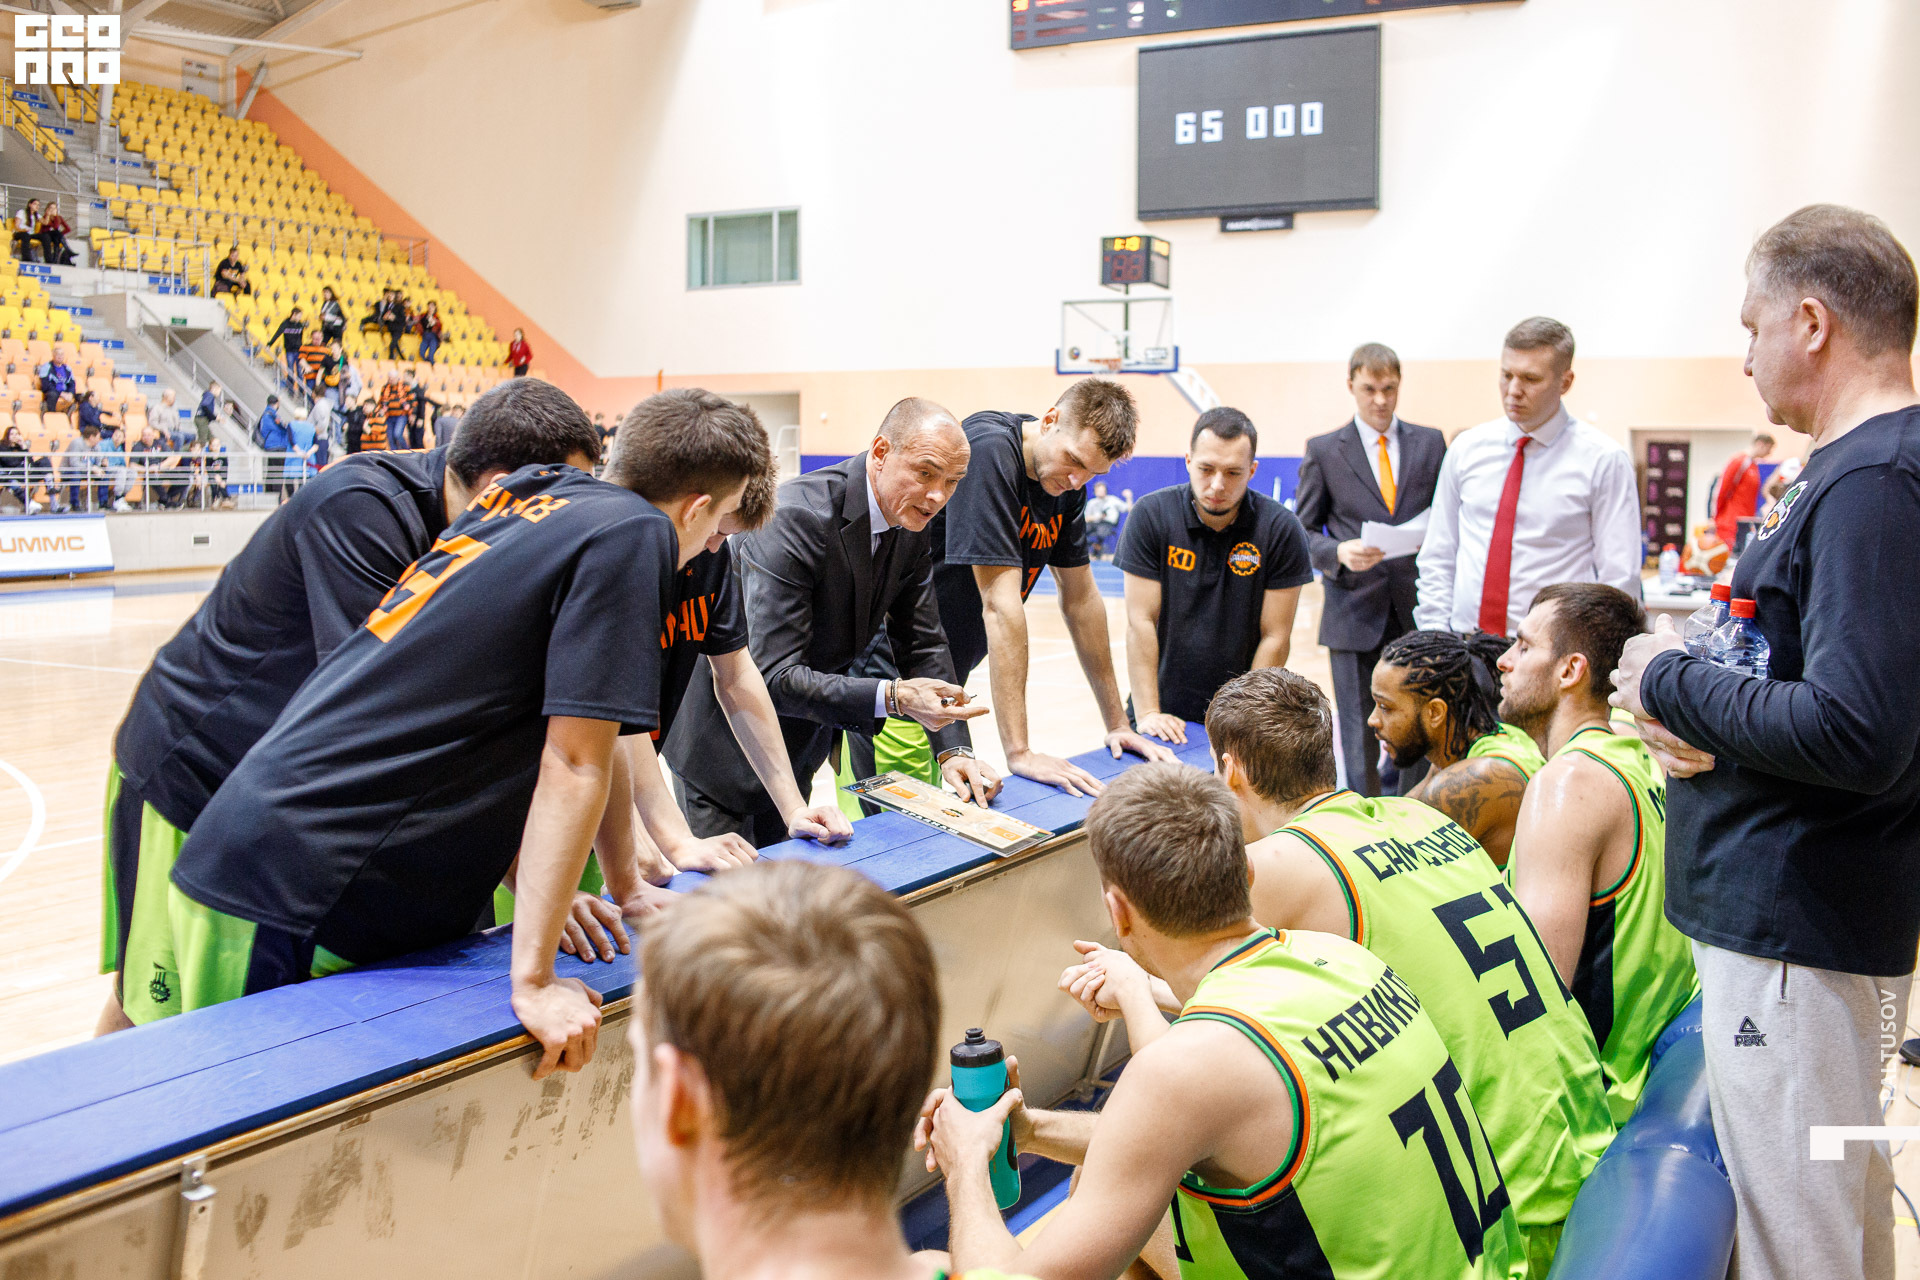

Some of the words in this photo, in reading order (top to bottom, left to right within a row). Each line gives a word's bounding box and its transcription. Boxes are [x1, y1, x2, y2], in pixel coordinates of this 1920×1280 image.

[1175, 109, 1223, 145] 65
[1246, 101, 1323, 140] 000
[0, 536, 85, 553] UMMC
[1168, 545, 1196, 572] KD
[1734, 1033, 1768, 1047] PEAK
